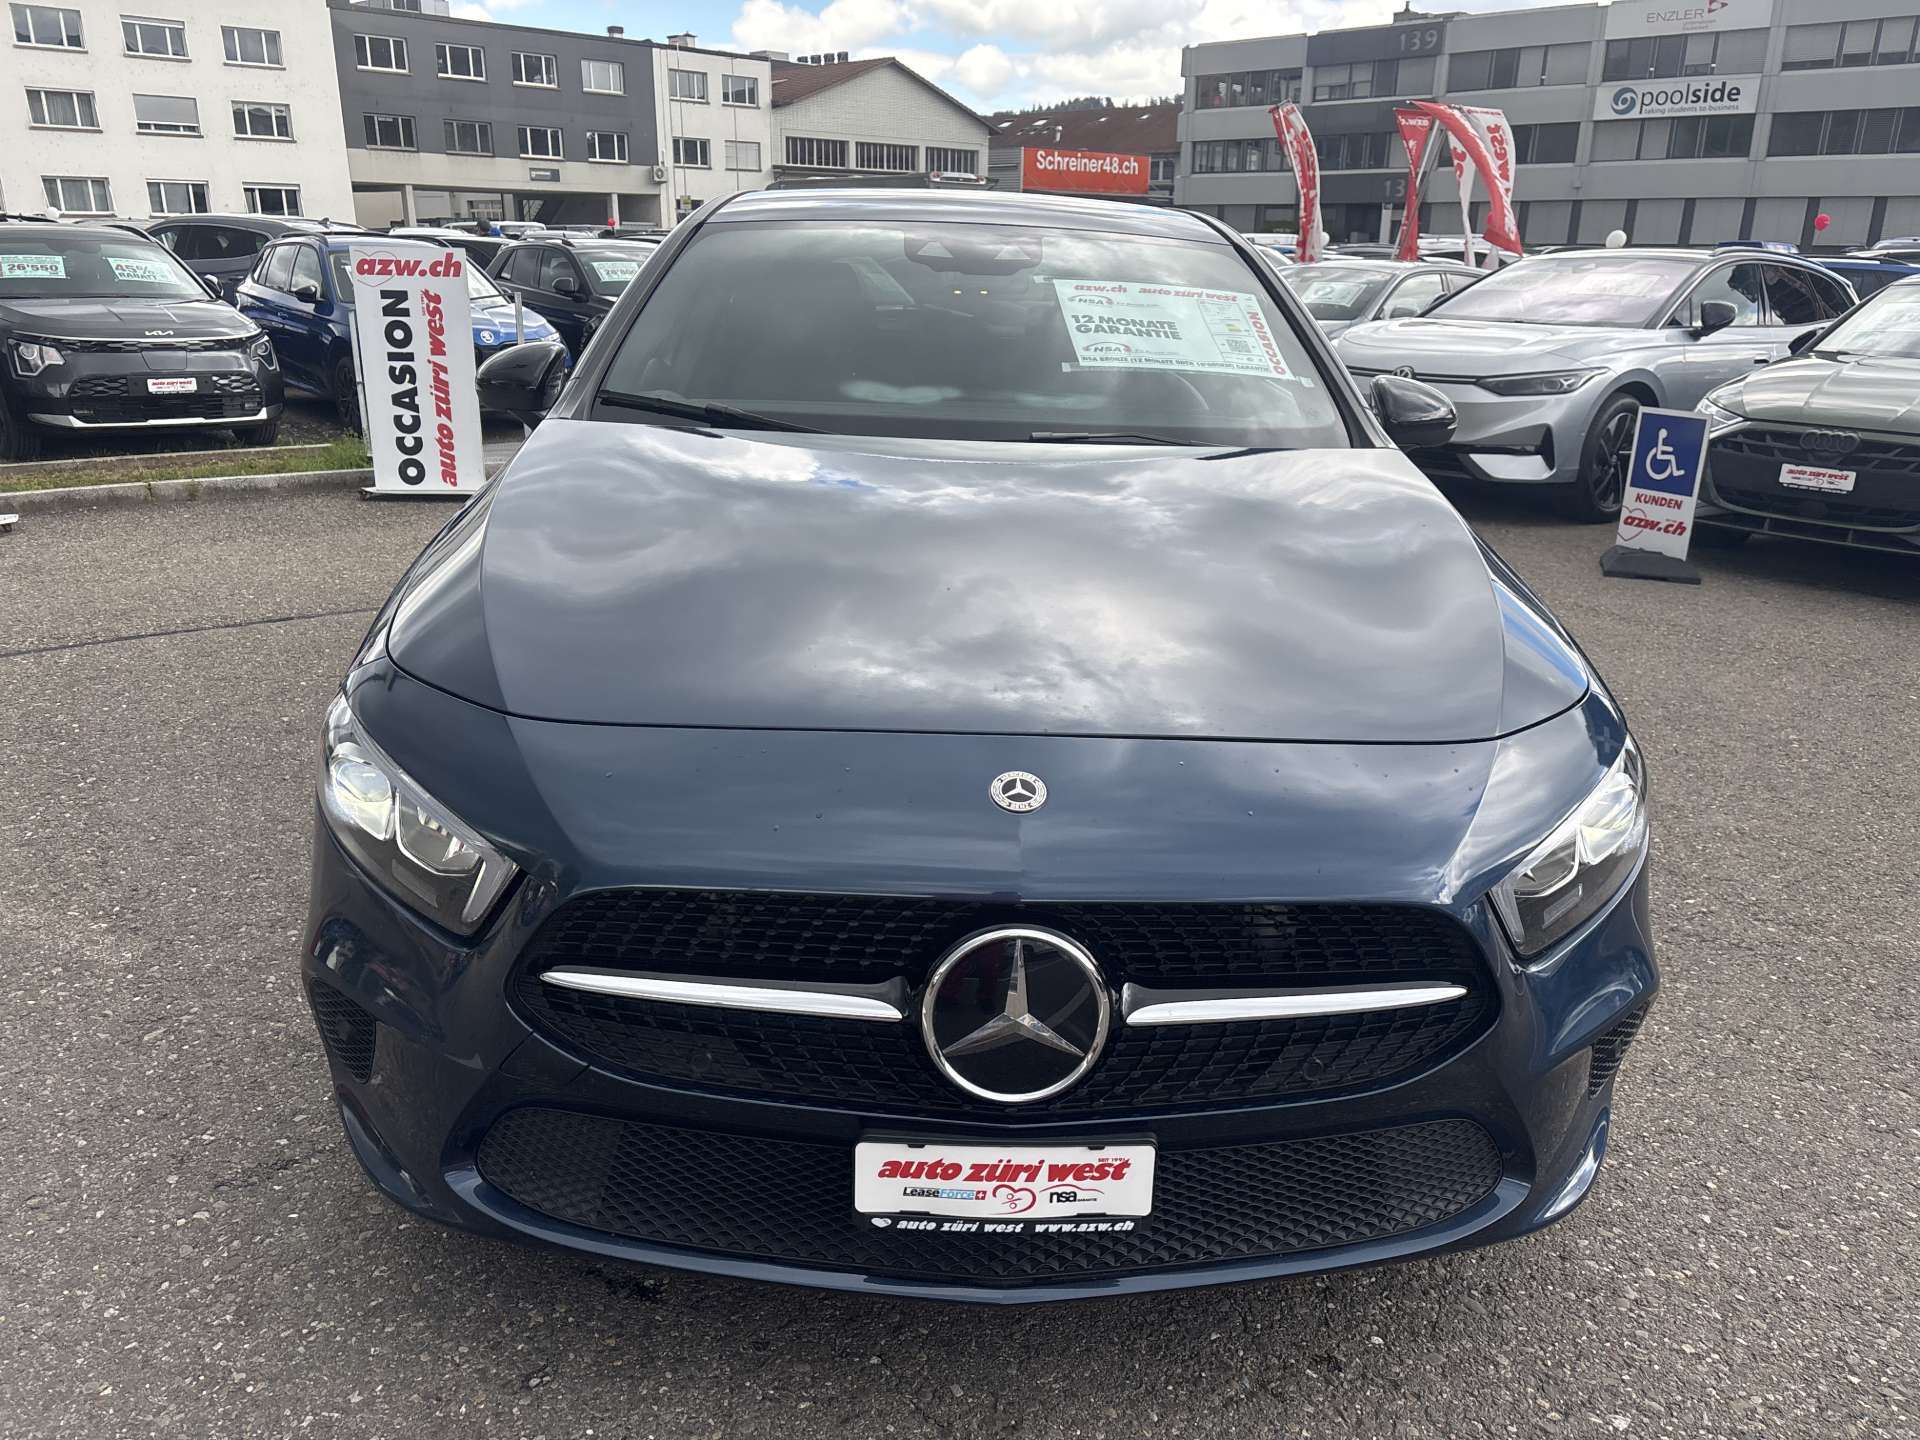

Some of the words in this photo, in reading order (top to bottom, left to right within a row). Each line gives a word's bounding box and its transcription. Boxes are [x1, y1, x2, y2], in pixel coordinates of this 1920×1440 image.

[1646, 9, 1705, 23] ENZLER
[1400, 30, 1438, 51] 139
[1639, 81, 1741, 114] poolside
[1644, 106, 1666, 115] taking
[1667, 104, 1698, 113] students
[1708, 103, 1739, 112] business
[1036, 150, 1139, 176] Schreiner48.ch
[8, 263, 59, 272] 26'550
[115, 264, 155, 275] 45%
[356, 252, 462, 278] azw.ch
[117, 272, 157, 280] RABATT
[1073, 284, 1128, 294] azw.ch
[1138, 286, 1172, 296] auto
[1205, 292, 1237, 302] west
[1078, 297, 1105, 305] NSA
[421, 288, 447, 356] west
[1071, 314, 1096, 324] 12
[1098, 315, 1178, 331] MONATE
[1075, 323, 1184, 341] GARANTIE
[1246, 311, 1286, 376] OCCASION
[379, 289, 426, 486] OCCASION
[427, 358, 452, 422] züri
[435, 422, 458, 487] auto
[1786, 468, 1808, 476] auto
[1828, 473, 1849, 481] west
[1635, 492, 1683, 510] KUNDEN
[1623, 515, 1687, 536] azw.ch
[878, 1158, 963, 1181] auto
[962, 1158, 1045, 1183] züri
[1047, 1159, 1131, 1182] west
[902, 1186, 975, 1201] LeaseForce
[1049, 1190, 1077, 1203] nsa
[897, 1219, 937, 1231] auto
[940, 1219, 979, 1232] züri
[983, 1222, 1024, 1234] west
[1034, 1220, 1135, 1234] www.azw.ch
